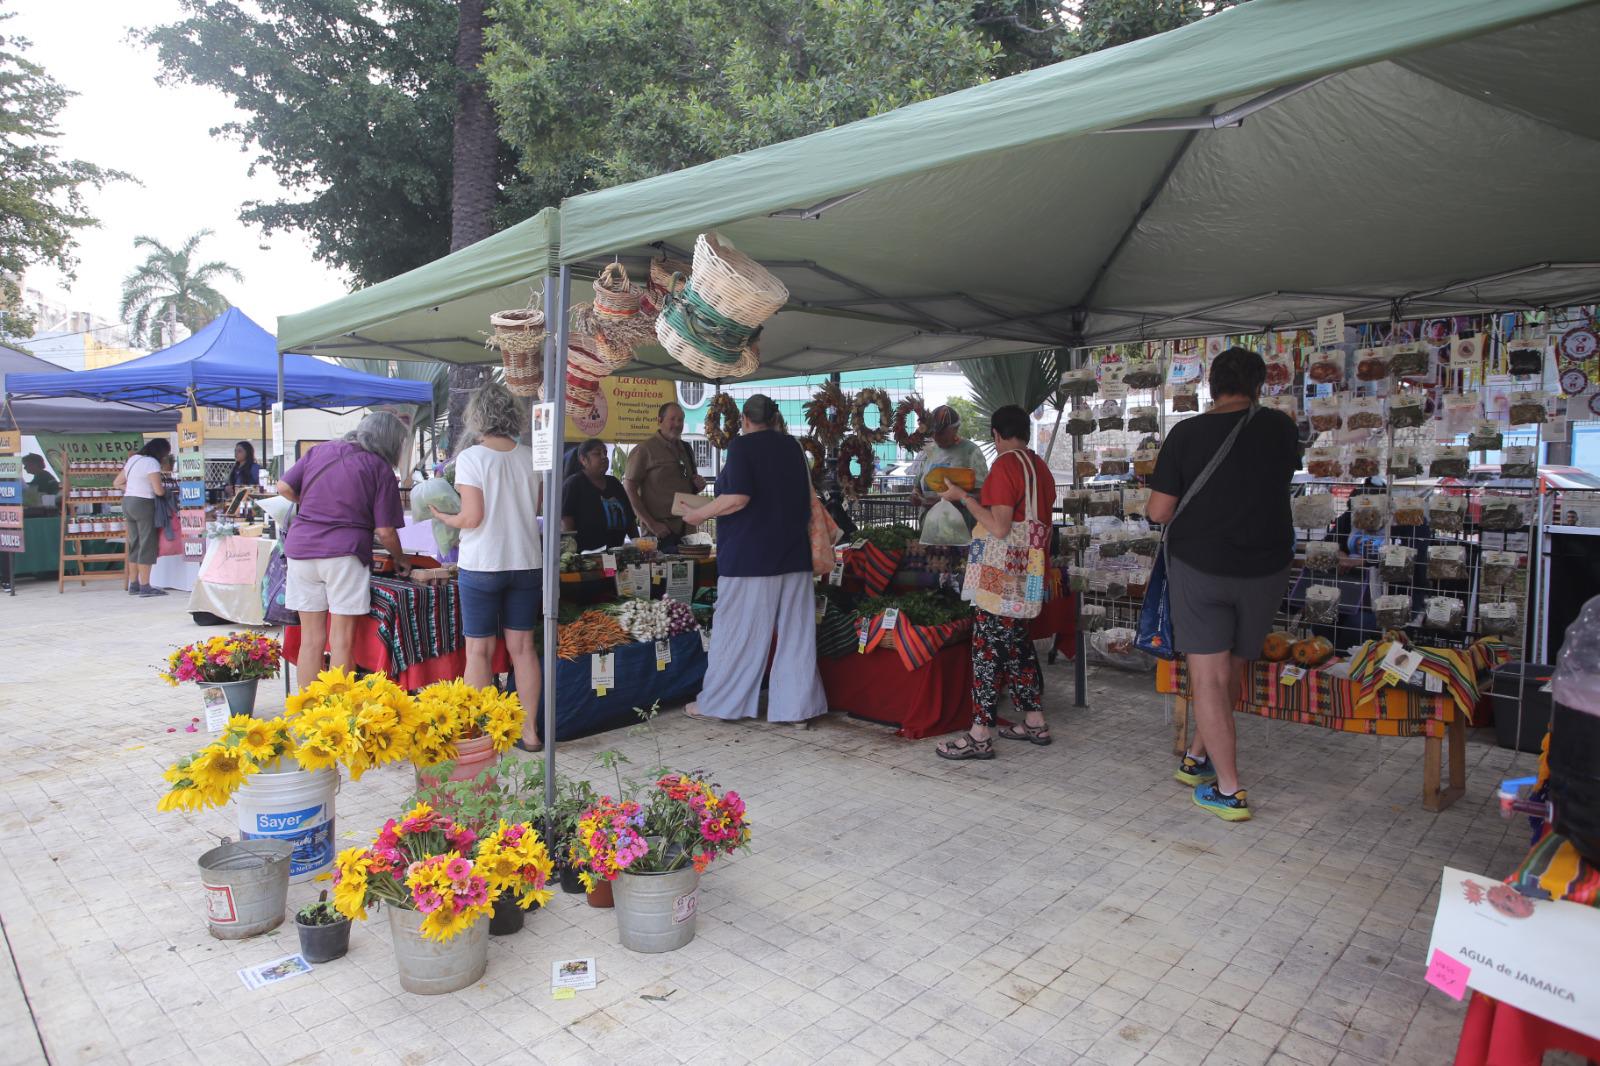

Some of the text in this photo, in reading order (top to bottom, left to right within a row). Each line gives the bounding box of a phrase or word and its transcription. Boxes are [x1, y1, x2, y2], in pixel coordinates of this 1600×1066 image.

[617, 376, 657, 385] La Rosa
[612, 387, 663, 399] Orgánicos
[58, 441, 139, 453] VIDA VERDE
[182, 487, 201, 499] POLLEN
[259, 815, 302, 830] Sayer
[1459, 946, 1576, 1003] AGUA de JAMAICA
